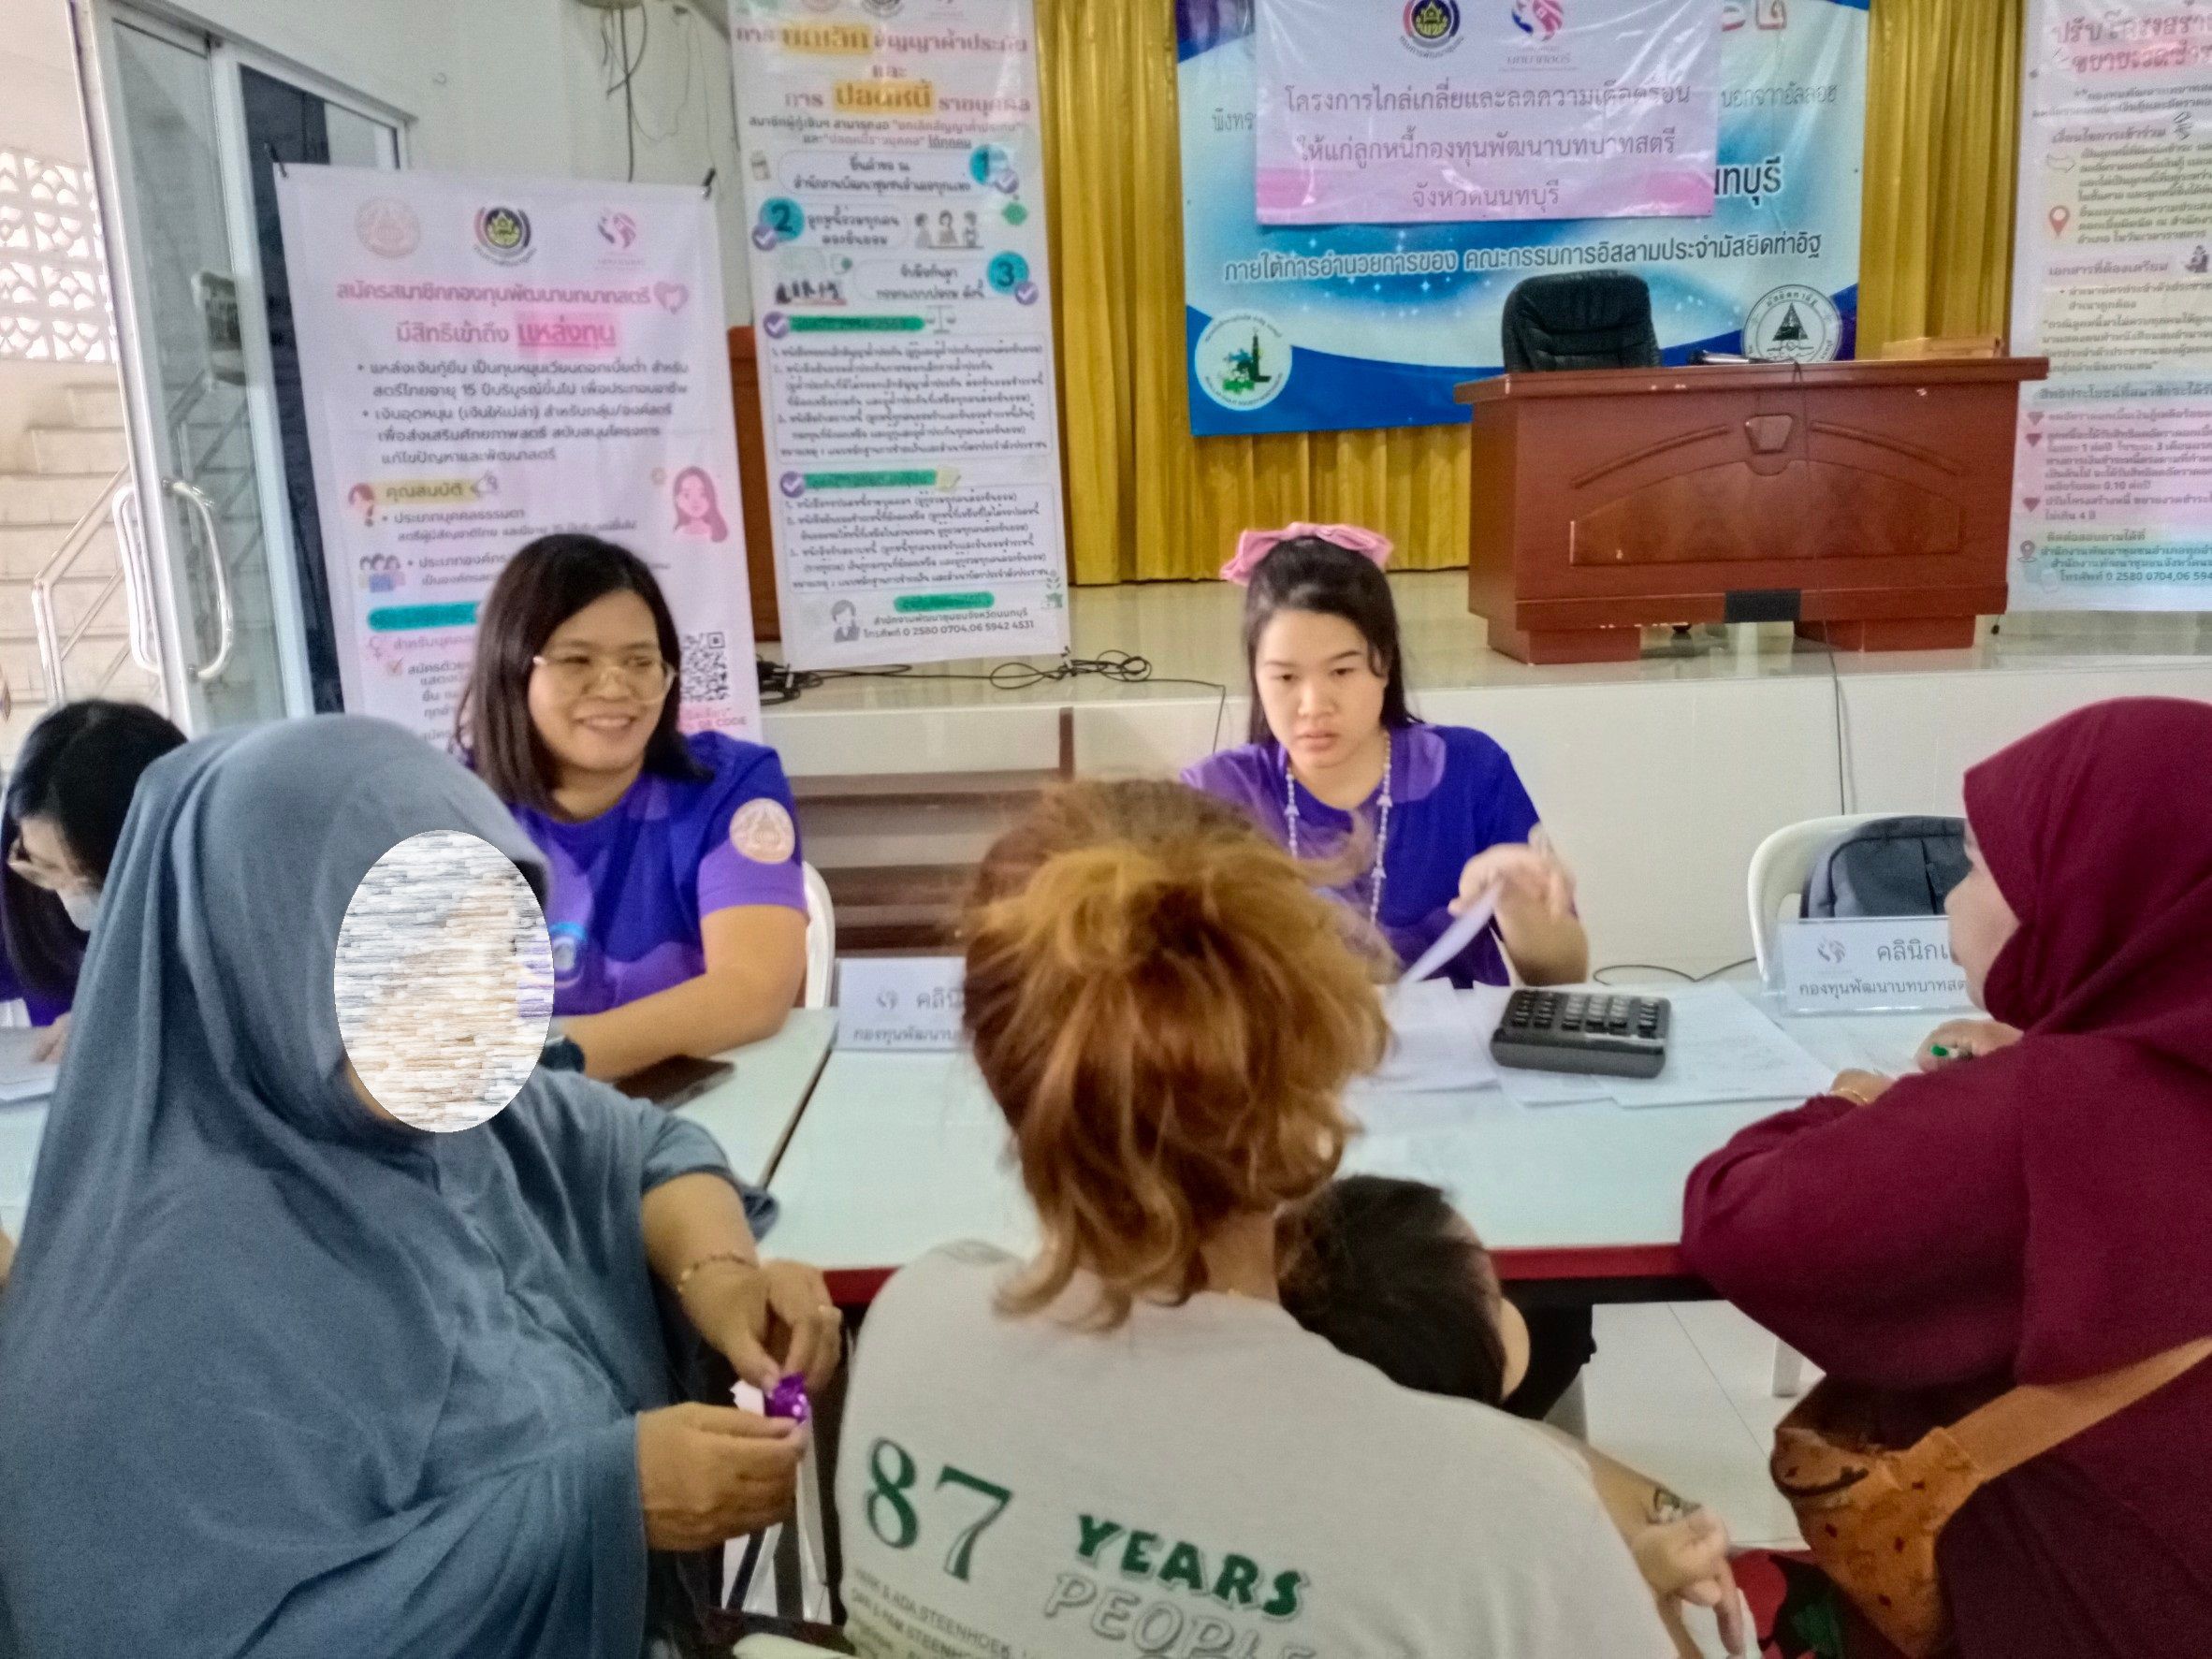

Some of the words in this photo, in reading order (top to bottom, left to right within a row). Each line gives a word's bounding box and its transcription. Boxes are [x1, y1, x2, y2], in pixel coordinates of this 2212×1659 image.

[1284, 77, 1692, 112] โครงการไกล่เกลี่ยและลดความเดือดรอน
[1412, 179, 1560, 213] จังหวดนนทบุรี
[772, 204, 793, 232] 2
[1224, 249, 1458, 282] ภายใต้การอำนวยการของ
[1464, 230, 1823, 272] คณะกรรมการอิสลามประจำมัสยิดท่าอิฐ
[997, 260, 1015, 287] 3
[461, 383, 477, 397] 15
[1799, 979, 1967, 1000] กองทุนพัฒนาบทบาทสต
[866, 1435, 1013, 1583] 87
[1076, 1513, 1311, 1623] YEARS
[1042, 1571, 1317, 1659] PEOPL
